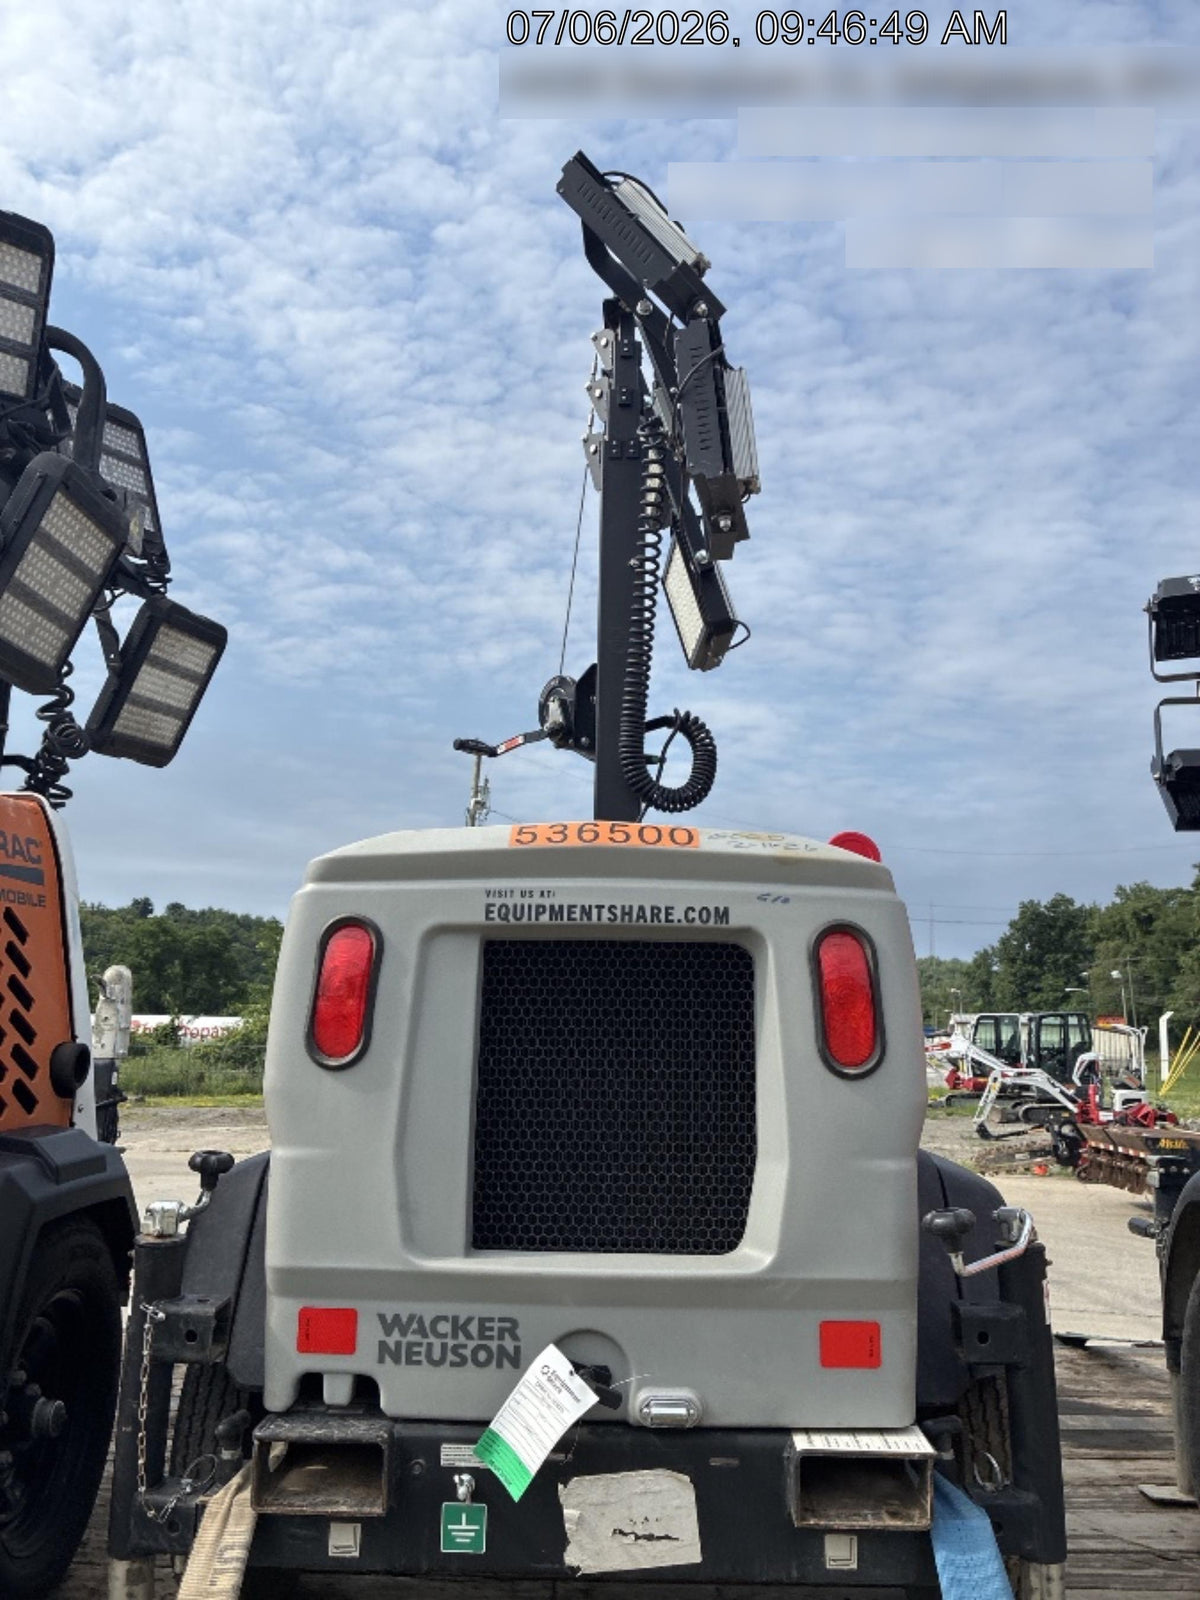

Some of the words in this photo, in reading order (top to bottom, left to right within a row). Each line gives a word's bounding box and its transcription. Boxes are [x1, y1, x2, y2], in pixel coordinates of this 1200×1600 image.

[515, 822, 694, 846] 536500
[485, 889, 514, 898] VISIT
[520, 889, 534, 898] US
[485, 903, 730, 925] EQUIPMENTSHARE.COM
[377, 1313, 521, 1342] WACKER
[378, 1340, 521, 1369] NEUSON
